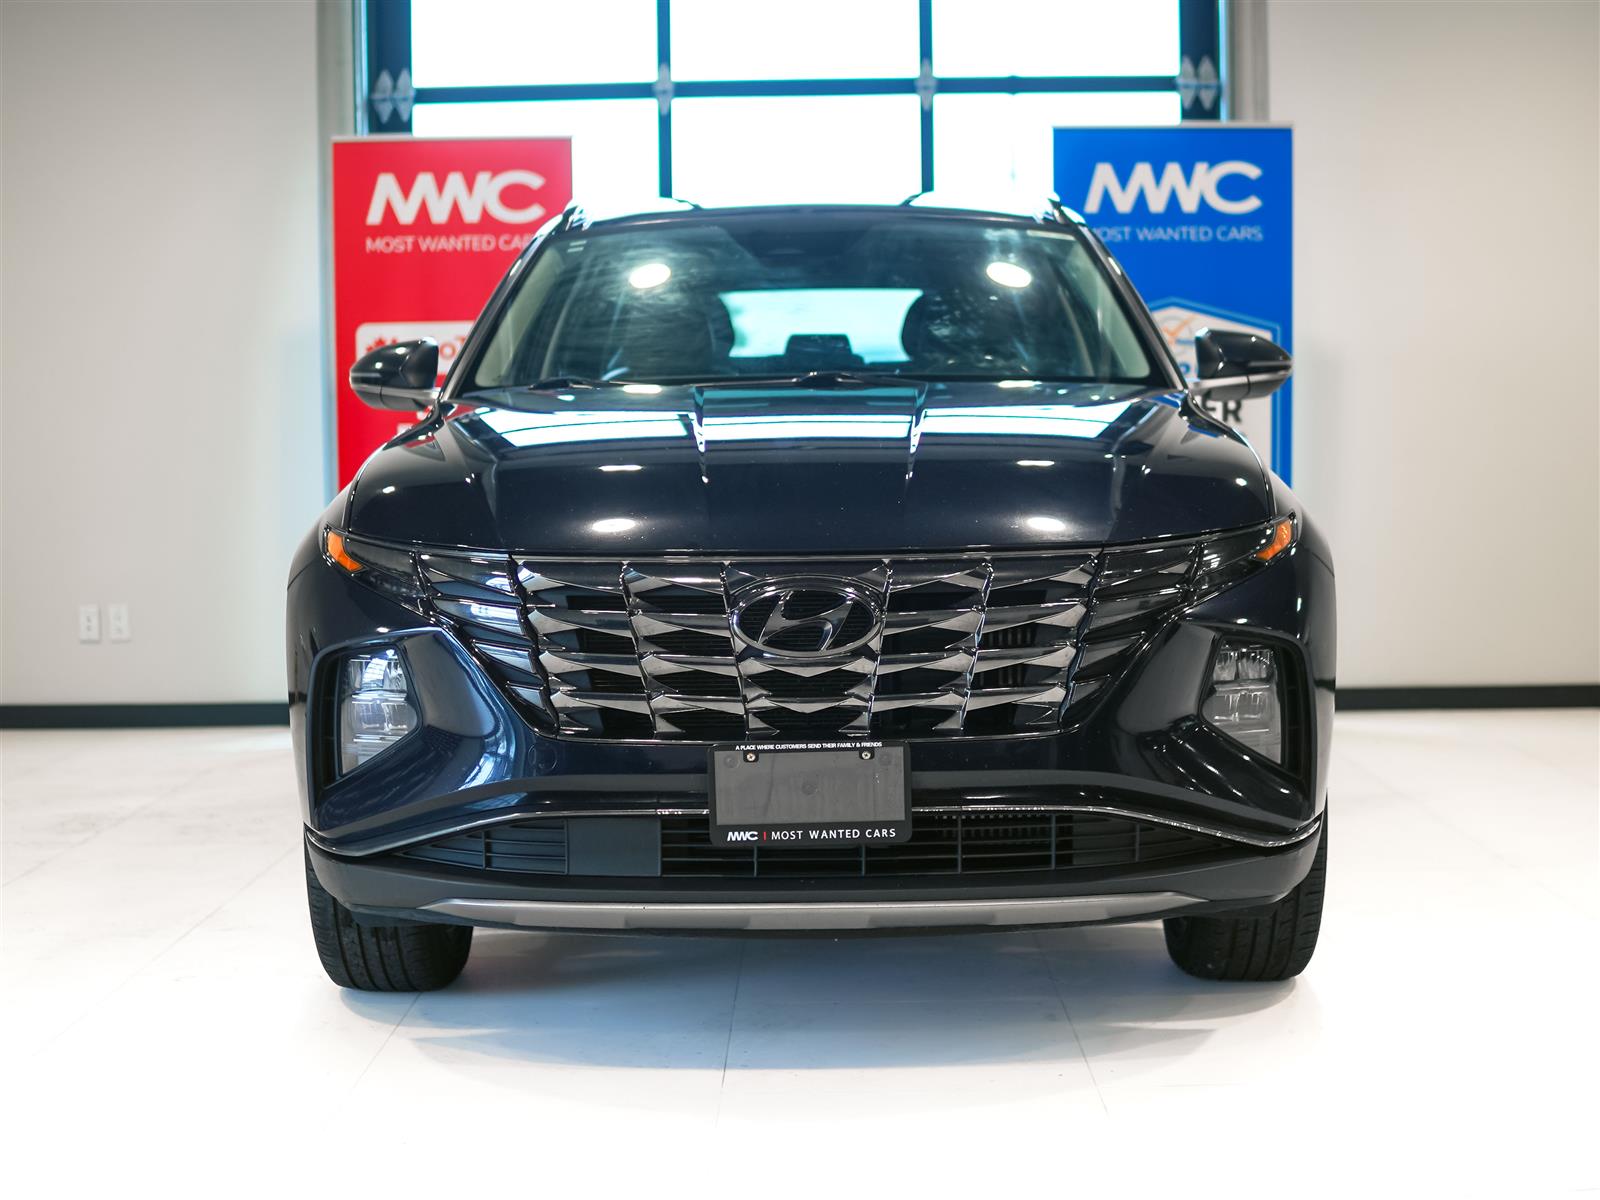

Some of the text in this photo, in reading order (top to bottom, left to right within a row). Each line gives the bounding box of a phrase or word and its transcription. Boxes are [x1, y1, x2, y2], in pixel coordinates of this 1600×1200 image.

[365, 169, 547, 226] MWC
[1084, 161, 1263, 215] MWC
[365, 235, 415, 253] MOST
[417, 234, 496, 252] WANTED
[1135, 226, 1213, 241] WANTED
[1216, 226, 1264, 242] CARS
[727, 828, 896, 842] MWC MOST WANTED CARS
